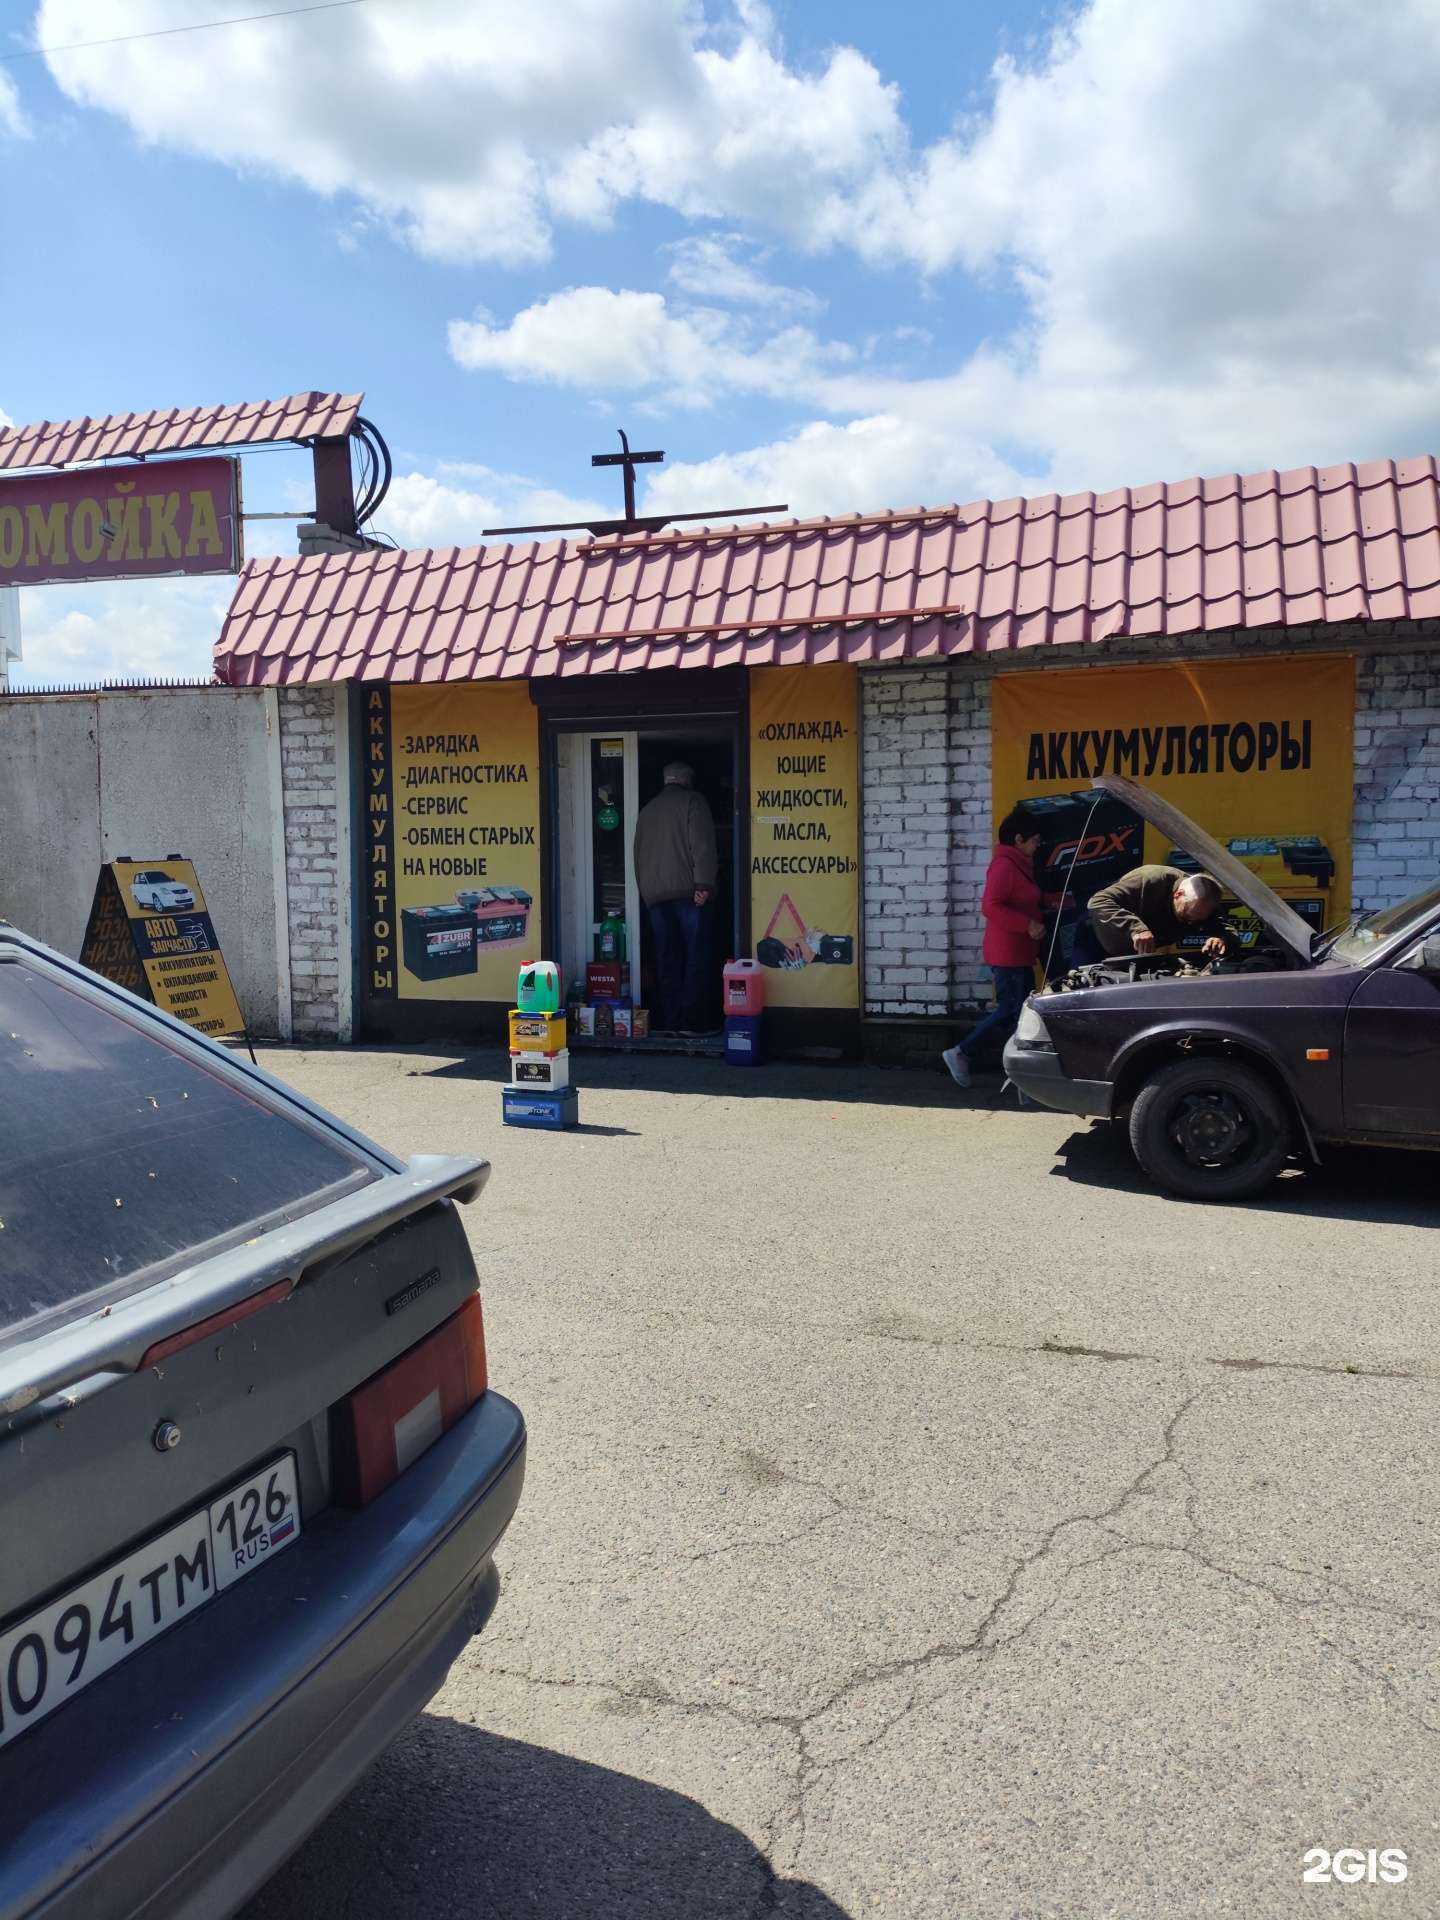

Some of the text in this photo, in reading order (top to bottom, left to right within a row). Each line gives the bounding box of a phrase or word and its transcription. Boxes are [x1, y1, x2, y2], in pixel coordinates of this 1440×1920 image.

[0, 481, 223, 569] ОМОЙКА
[400, 735, 479, 755] -ЗАРЯДКА
[1026, 720, 1312, 780] АККУМУЛЯТОРЫ
[401, 764, 528, 788] -ДИАГНОСТИКА
[777, 755, 826, 777] ЮЩИЕ
[401, 796, 469, 815] -СЕРВИС
[757, 788, 847, 811] ЖИДКОСТИ,
[369, 690, 392, 989] АККУМУЛЯТОРЫ
[402, 826, 535, 847] -ОБМЕН СТАРЫХ
[773, 822, 831, 842] МАСЛА,
[403, 857, 487, 877] НА НОВЫЕ
[752, 855, 858, 875] АКСЕССУАРЫ»
[144, 918, 178, 938] АВТО
[443, 932, 471, 942] ZUBR
[150, 937, 195, 954] ЗАПЧАСТИ
[158, 955, 216, 973] АККУМУЛЯТОРЫ
[163, 970, 219, 988] ОХЛАЖДАЮЩИЕ
[168, 988, 208, 1005] ЖИДКОСТИ
[234, 1534, 270, 1570] RUS
[0, 1474, 290, 1735] 094ТМ 126
